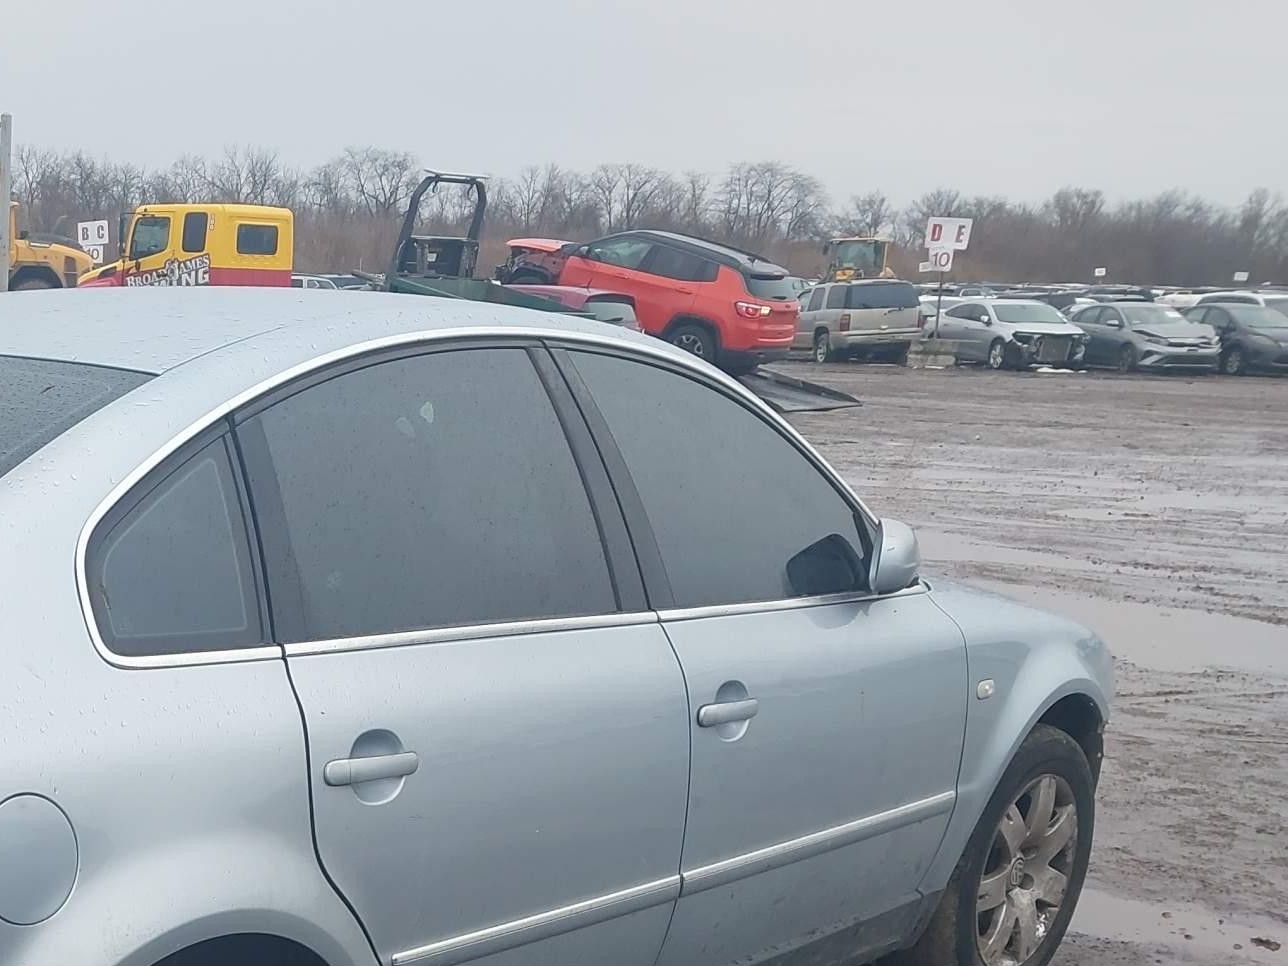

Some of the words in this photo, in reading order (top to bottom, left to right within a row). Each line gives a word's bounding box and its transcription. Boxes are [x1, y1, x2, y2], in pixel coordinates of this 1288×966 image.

[81, 226, 90, 241] B
[96, 224, 105, 239] C
[930, 223, 943, 242] D
[955, 224, 966, 243] E
[931, 251, 951, 268] 10
